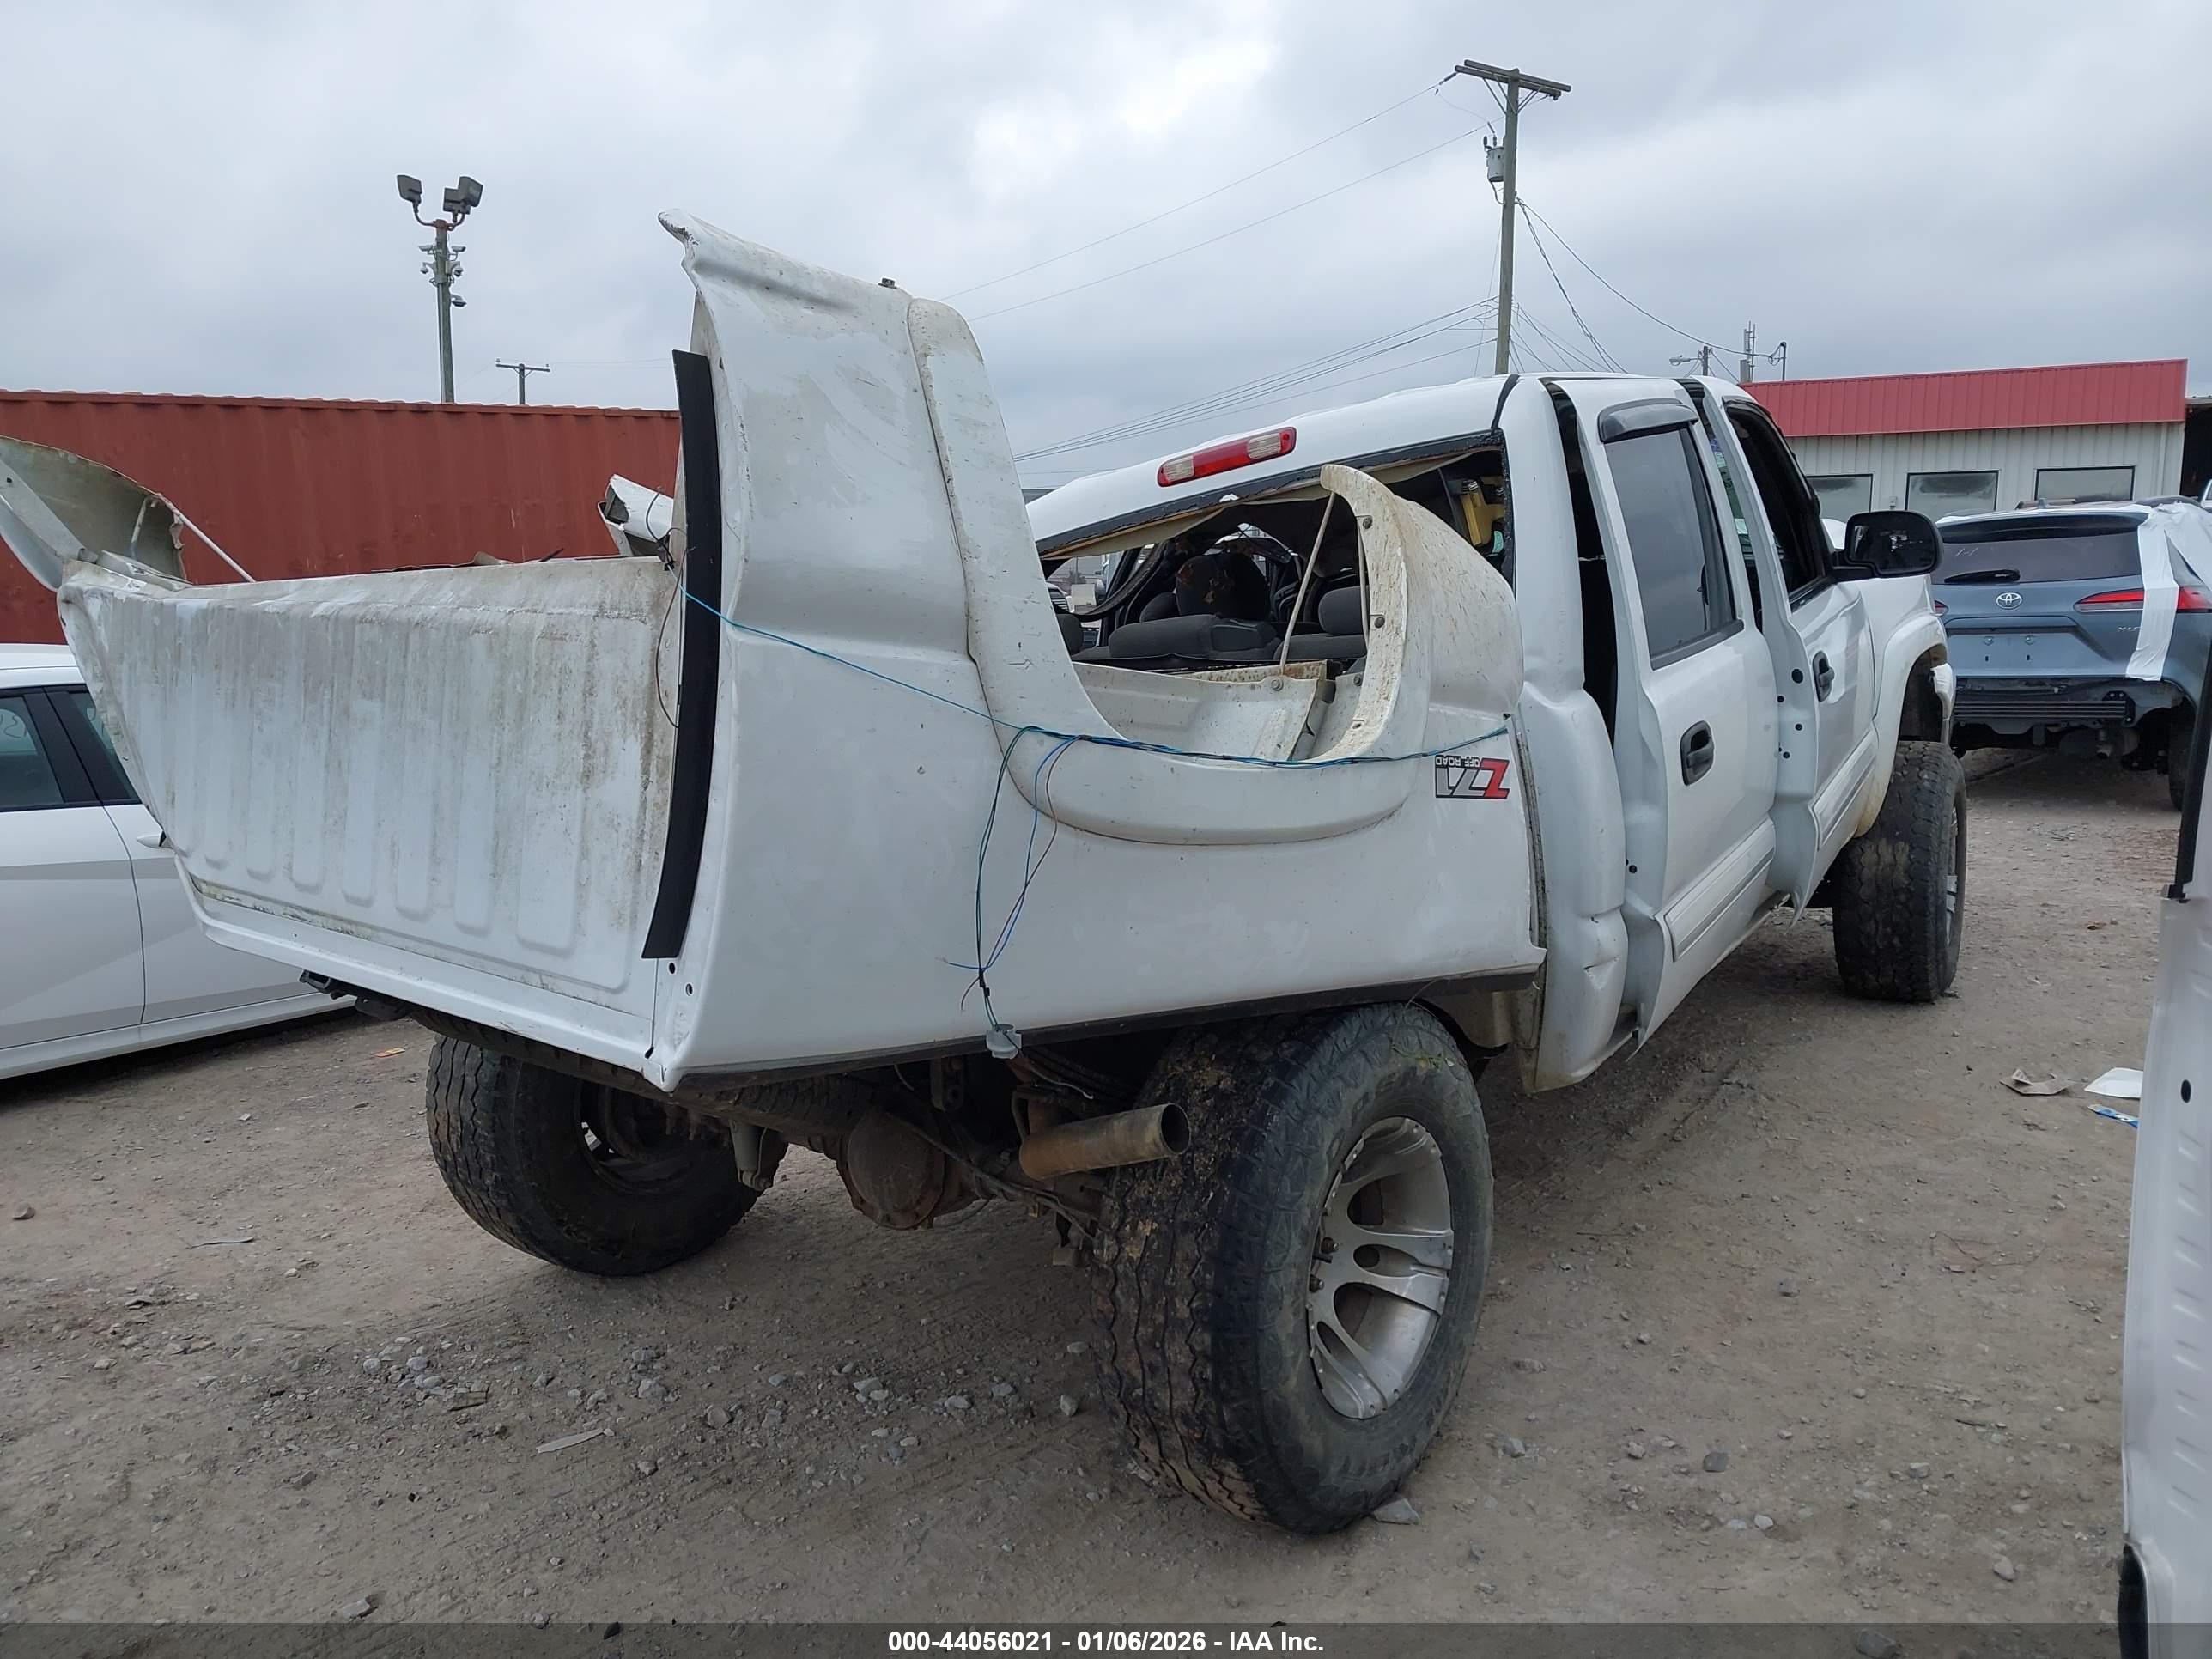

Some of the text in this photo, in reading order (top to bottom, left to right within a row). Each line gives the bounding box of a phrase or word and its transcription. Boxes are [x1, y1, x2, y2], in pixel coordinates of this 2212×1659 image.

[1436, 756, 1480, 767] OFF ROAD
[1435, 757, 1510, 799] Z71
